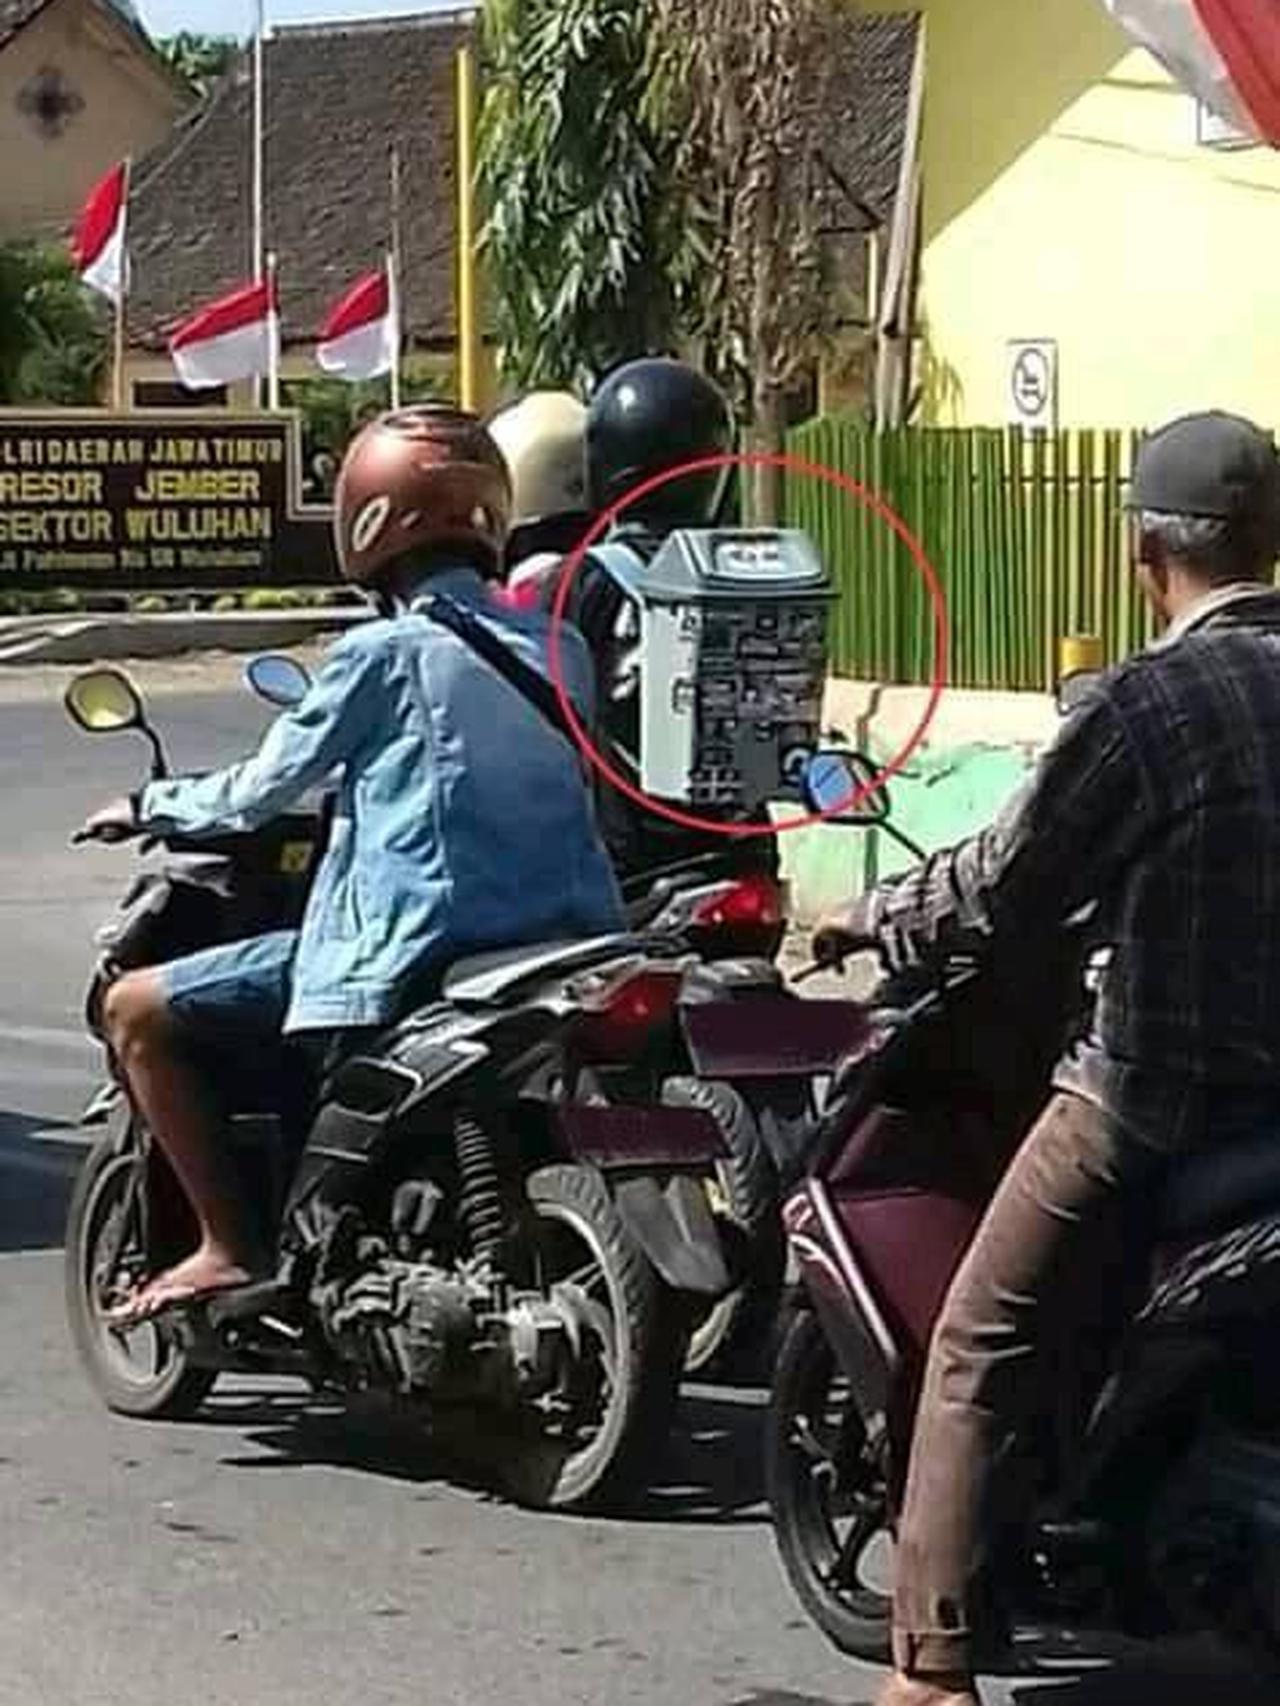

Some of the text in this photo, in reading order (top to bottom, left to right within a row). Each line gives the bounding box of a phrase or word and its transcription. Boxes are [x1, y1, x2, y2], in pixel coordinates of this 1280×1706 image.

[150, 438, 210, 463] JAWA
[211, 438, 283, 463] TIMUR
[0, 470, 261, 504] RESOR JEMBER
[126, 507, 272, 540] WULUHAN
